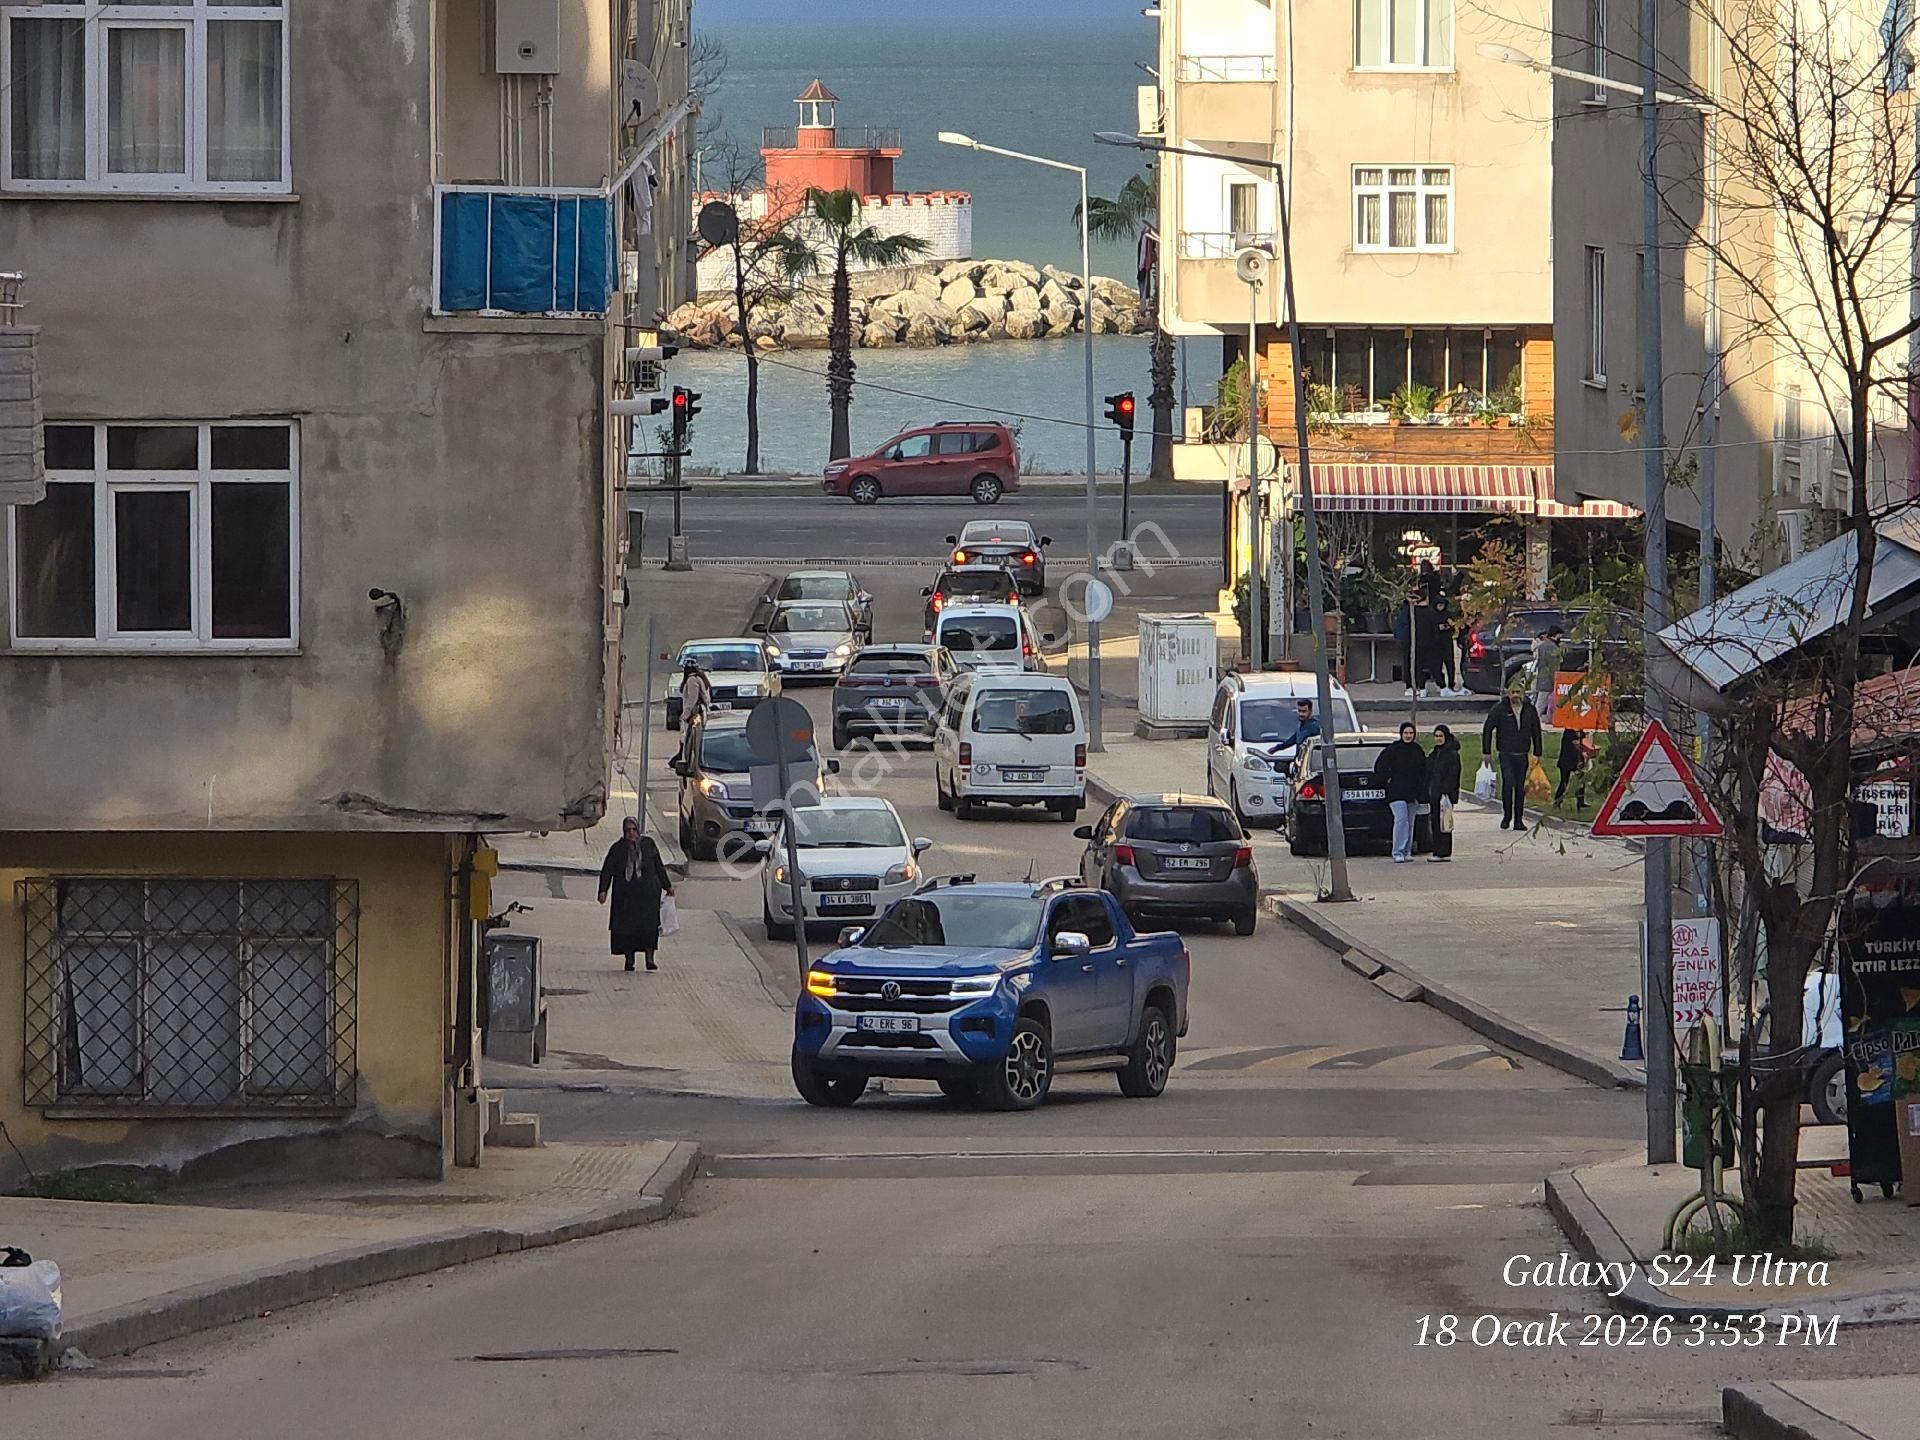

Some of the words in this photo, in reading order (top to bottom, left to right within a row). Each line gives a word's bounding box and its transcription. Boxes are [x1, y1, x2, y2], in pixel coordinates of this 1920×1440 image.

[863, 1018, 874, 1028] 42
[880, 1018, 896, 1029] ERE
[901, 1019, 913, 1030] 96
